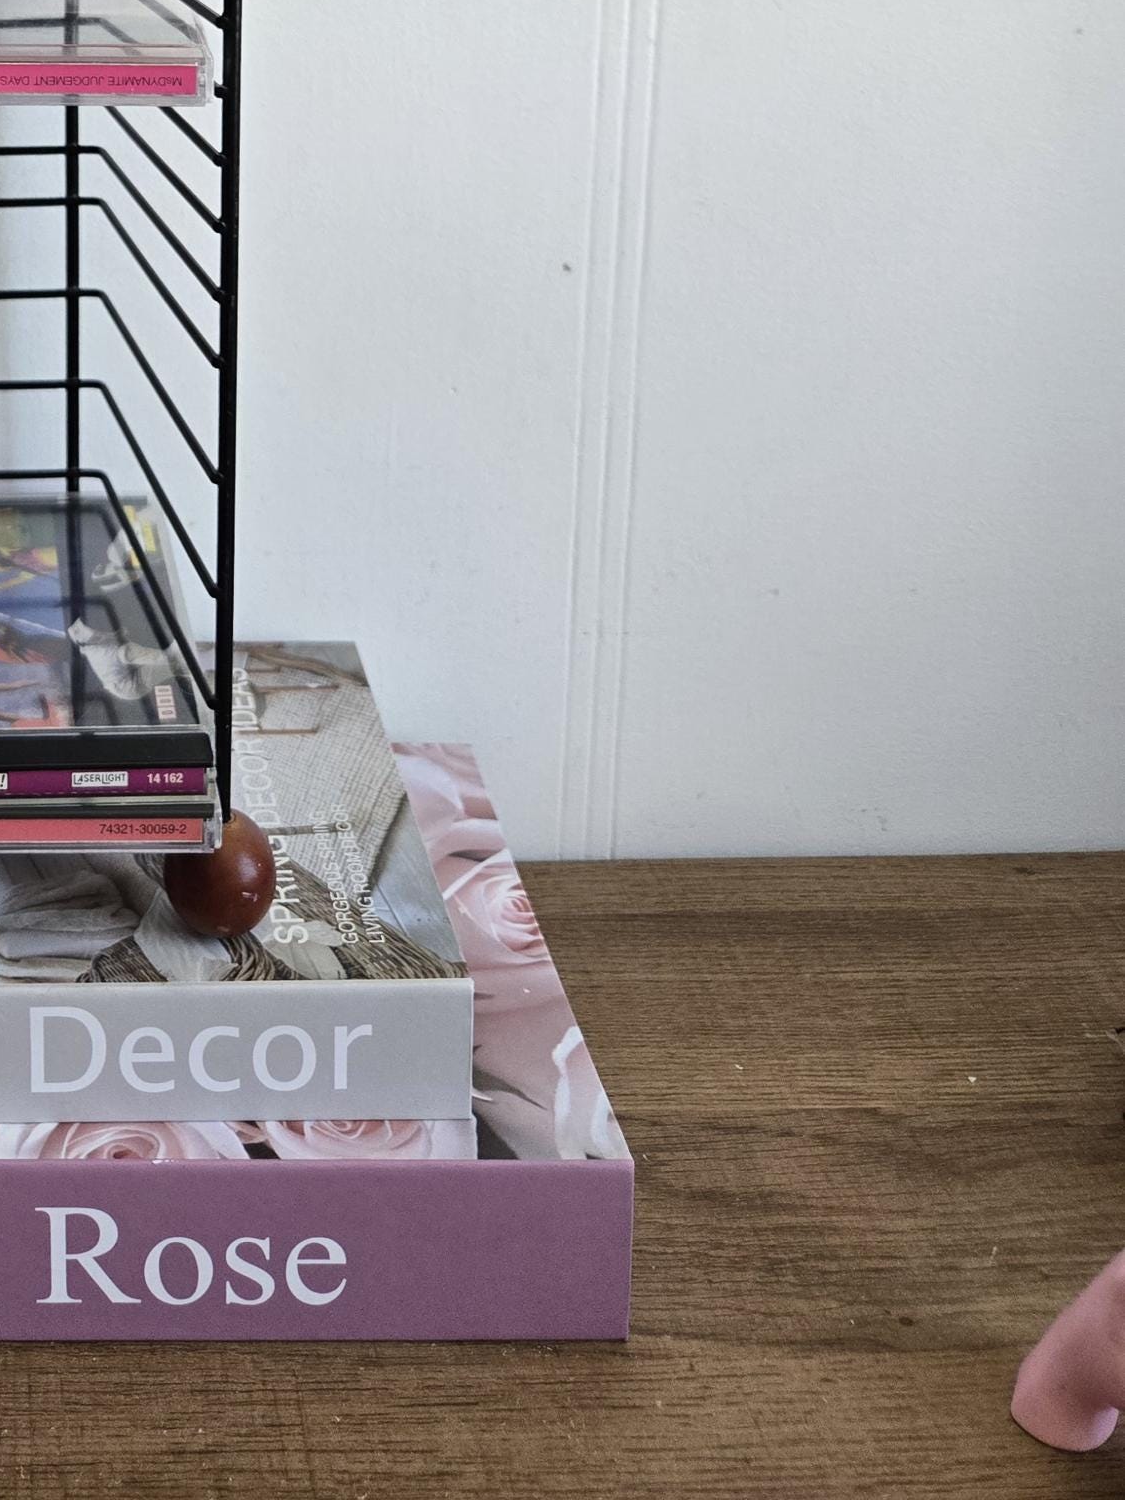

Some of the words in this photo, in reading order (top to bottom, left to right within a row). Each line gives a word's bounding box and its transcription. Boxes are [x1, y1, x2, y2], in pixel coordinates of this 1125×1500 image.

[0, 75, 30, 85] DAYS
[34, 76, 105, 86] JUDGEMENT
[147, 773, 160, 784] 14
[163, 772, 184, 783] 162
[235, 739, 281, 829] DECOR
[100, 823, 187, 835] 74321-30059-2
[331, 803, 359, 849] DECOR
[345, 850, 372, 894] ROOM
[323, 862, 359, 945] GORGEOUS
[357, 896, 385, 944] LIVING
[29, 1006, 372, 1093] Decor
[35, 1205, 348, 1305] Rose
